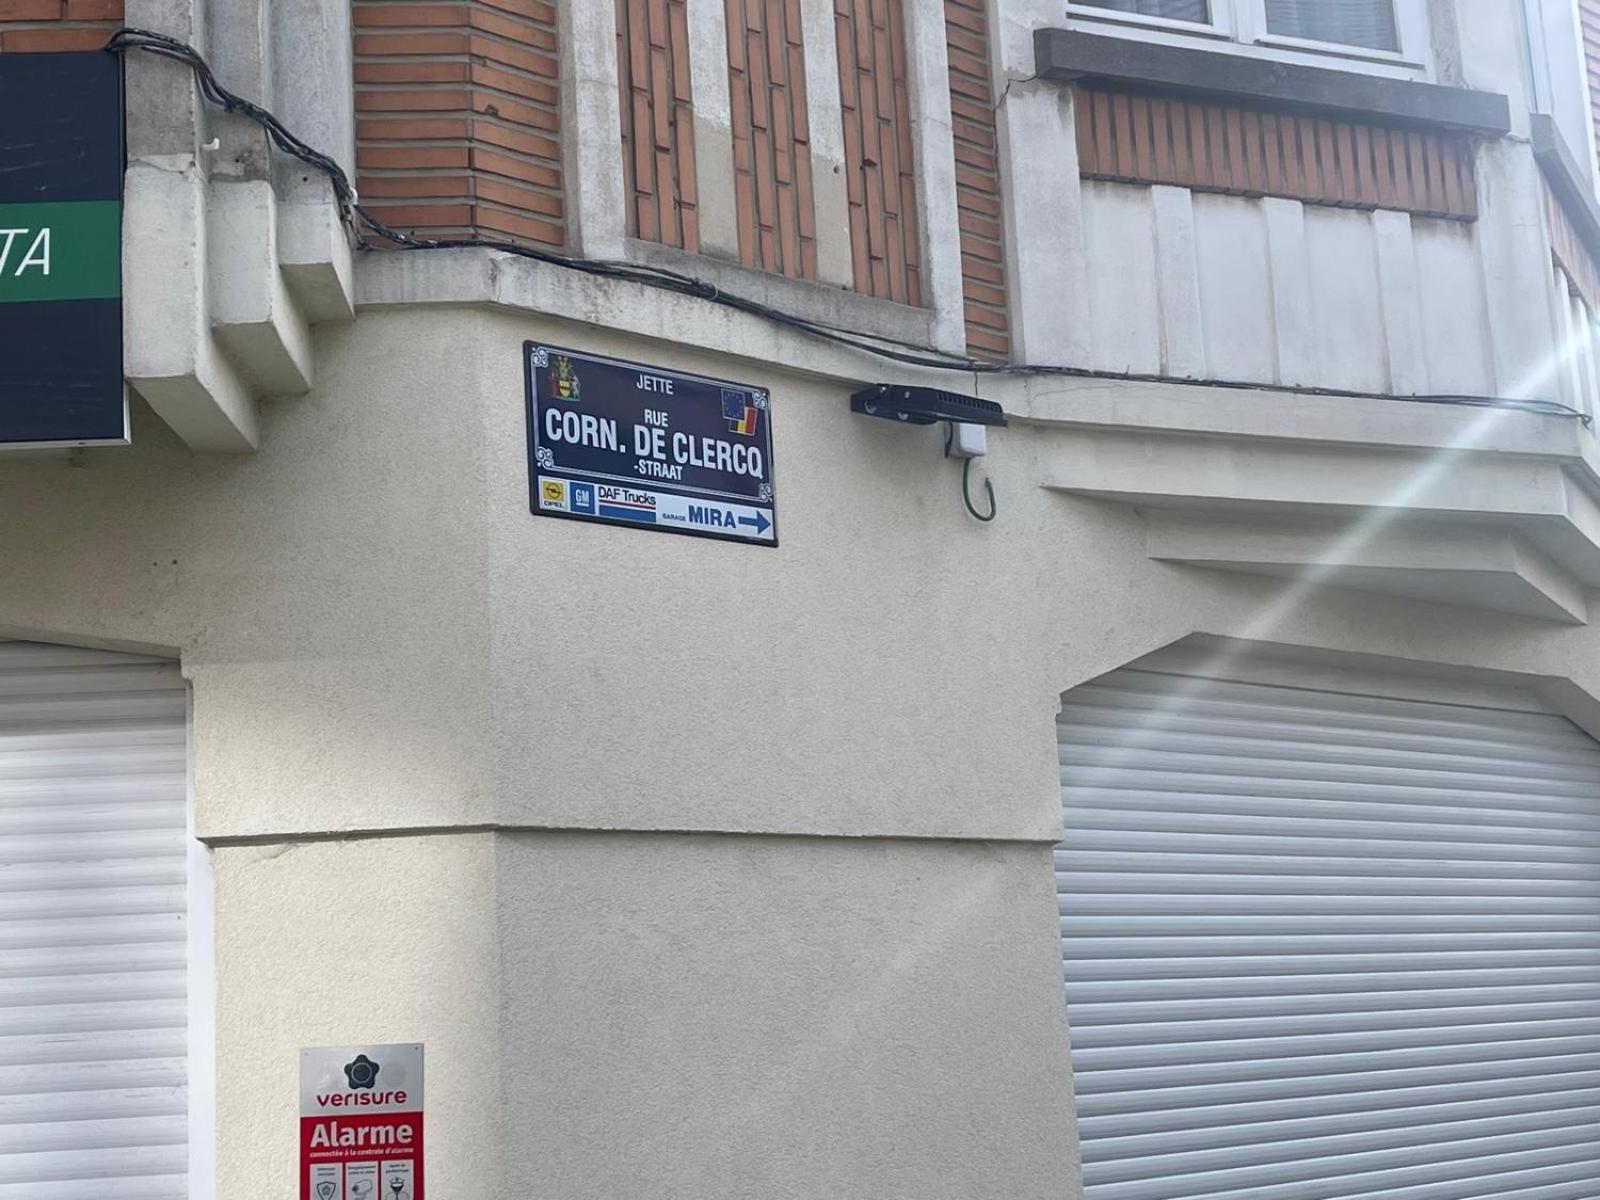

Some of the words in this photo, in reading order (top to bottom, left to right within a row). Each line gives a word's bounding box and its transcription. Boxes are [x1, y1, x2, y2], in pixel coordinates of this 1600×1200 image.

[636, 374, 674, 395] JETTE
[644, 409, 669, 428] RUE
[545, 408, 626, 453] CORN.
[634, 425, 666, 460] DE
[672, 431, 764, 479] CLERCQ
[633, 459, 683, 480] -STRAAT
[543, 500, 564, 509] OPEL
[575, 489, 590, 503] GM
[598, 486, 620, 500] DAF
[622, 489, 657, 506] Trucks
[662, 513, 686, 522] GARAGE
[688, 504, 737, 529] MIRA
[317, 1090, 407, 1107] verisure
[310, 1121, 413, 1148] Alarme
